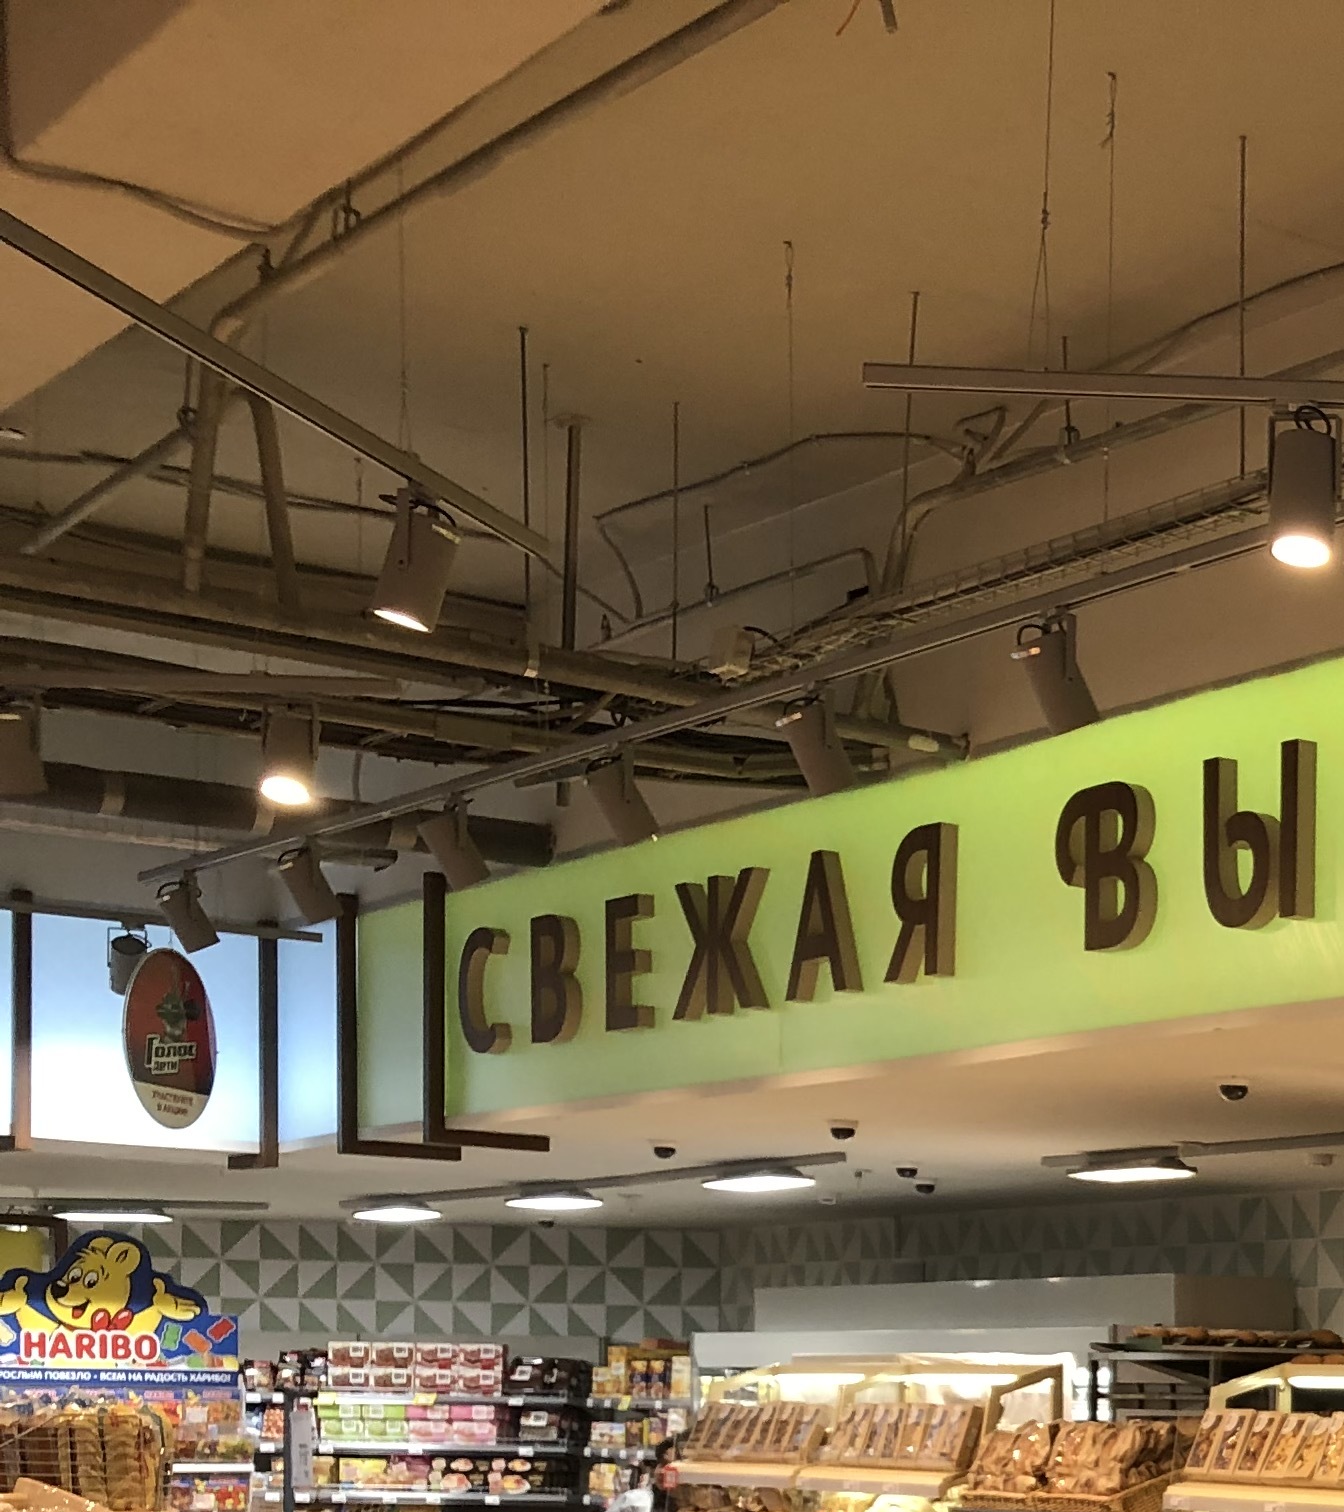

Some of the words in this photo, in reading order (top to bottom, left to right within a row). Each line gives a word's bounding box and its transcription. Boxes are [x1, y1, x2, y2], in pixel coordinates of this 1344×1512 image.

[458, 821, 959, 1055] СВЕЖАЯ
[23, 1331, 158, 1360] HARIBO
[45, 1371, 91, 1381] ПОВЕЗЛО
[100, 1372, 126, 1381] ВСЕМ
[129, 1373, 143, 1381] НА
[144, 1373, 187, 1383] РАДОСТЬ
